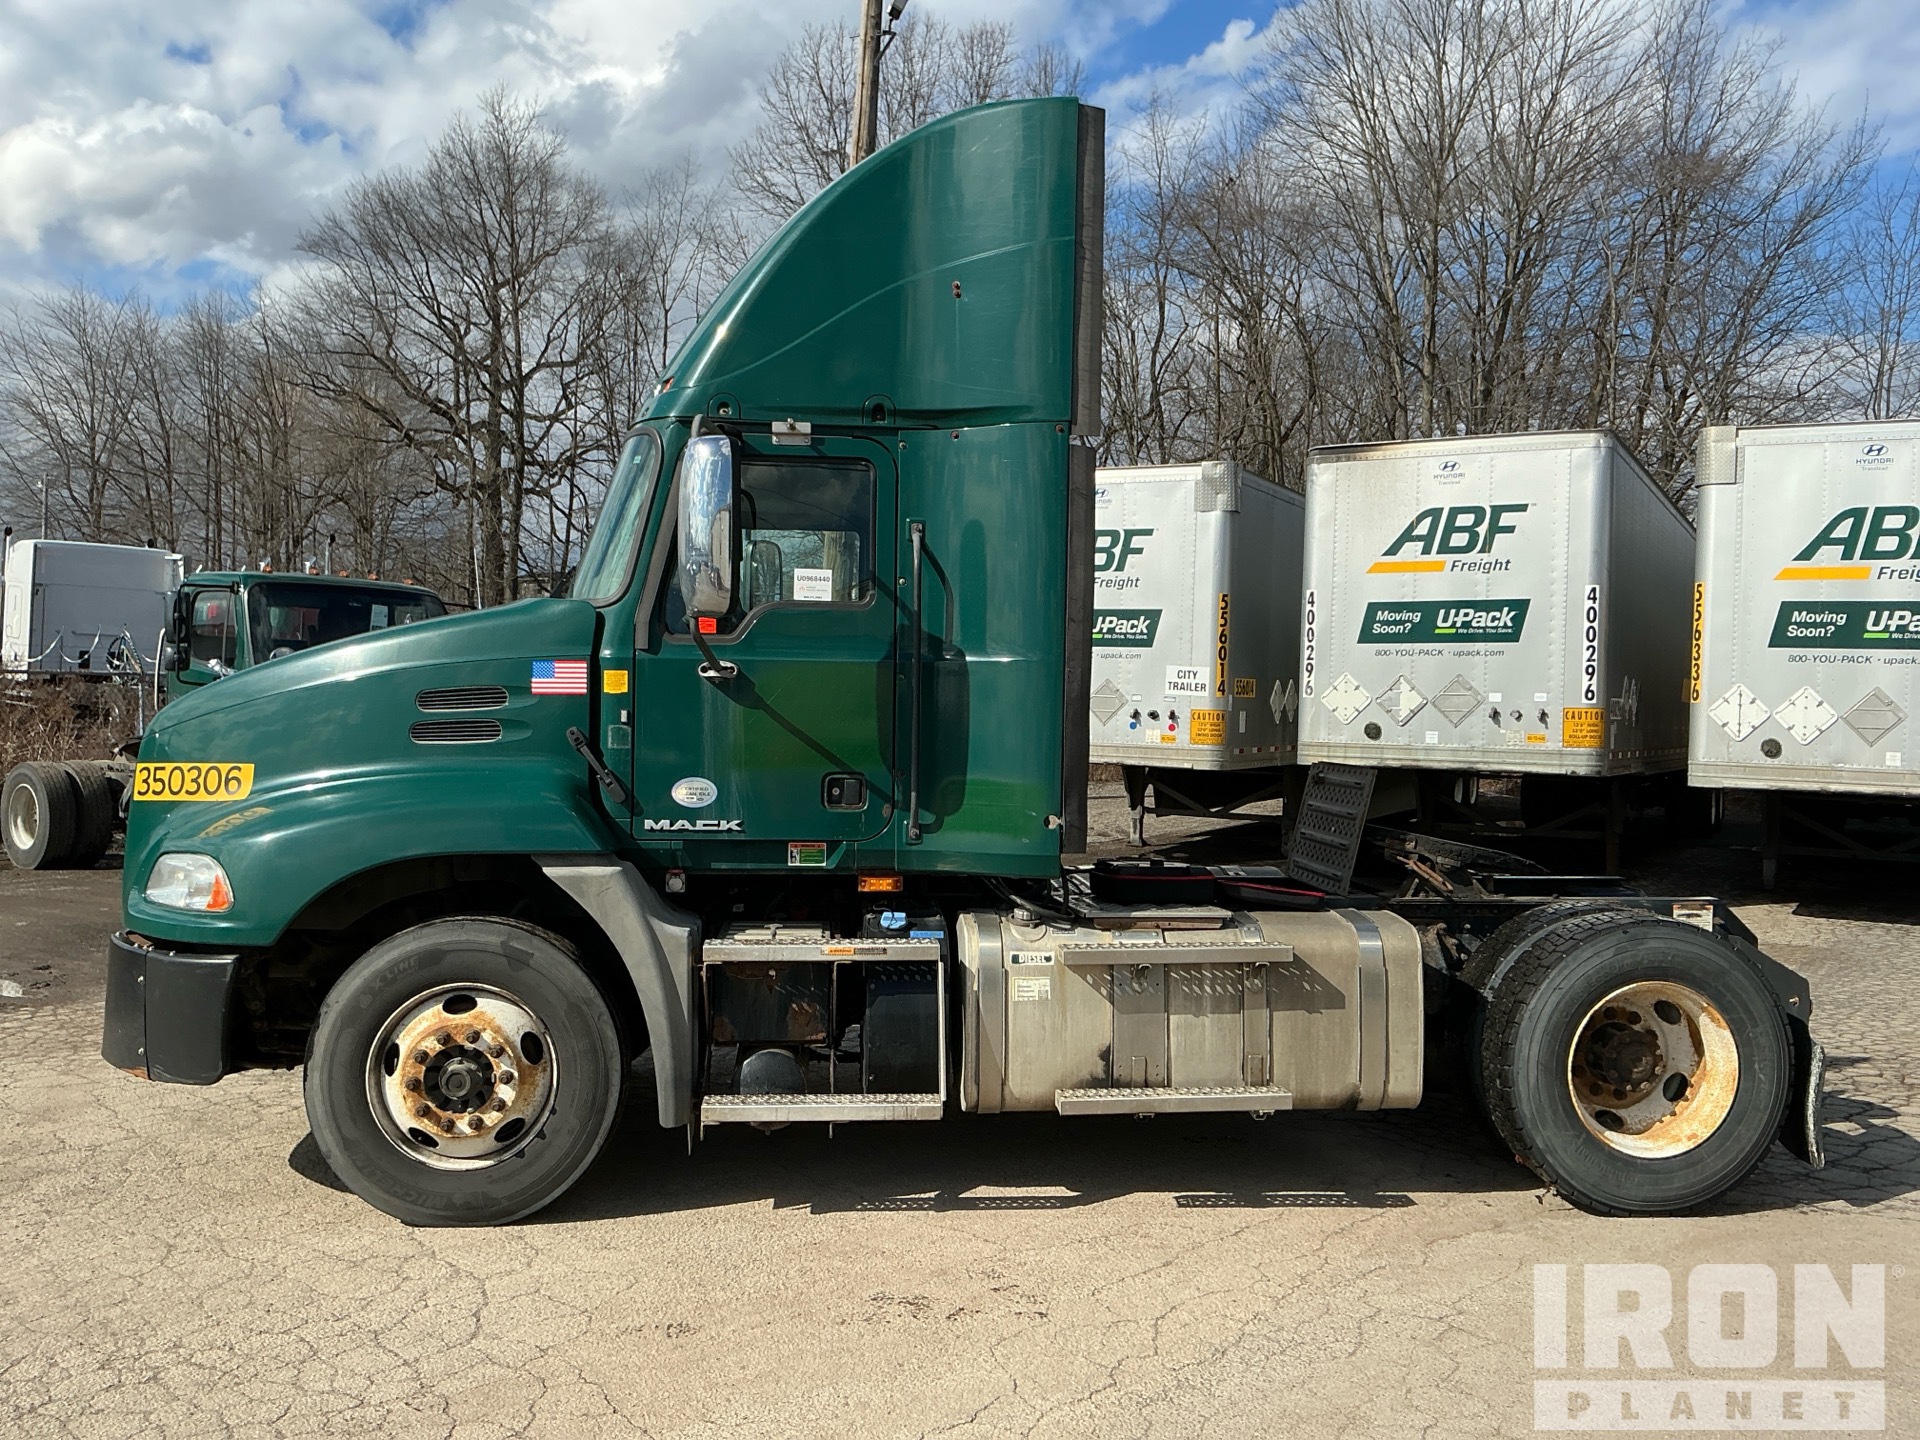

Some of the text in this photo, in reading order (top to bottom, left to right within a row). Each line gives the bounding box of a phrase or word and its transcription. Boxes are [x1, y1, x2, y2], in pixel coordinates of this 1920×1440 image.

[1433, 472, 1466, 480] HYUNDAI
[1381, 503, 1529, 557] ABF
[1791, 505, 1920, 561] AB
[1094, 528, 1155, 572] BF
[1450, 558, 1511, 574] Freight
[1877, 564, 1920, 583] Freig
[1375, 610, 1421, 622] Moving
[1791, 611, 1847, 625] Moving
[1866, 610, 1920, 632] U-Pa
[1372, 623, 1412, 634] Soon?
[1787, 625, 1835, 637] Soon?
[1217, 594, 1229, 695] 556014
[1304, 591, 1316, 696] 400296
[1585, 587, 1598, 701] 400296
[1691, 584, 1703, 701] 556336
[1100, 652, 1141, 660] upack.com
[1374, 649, 1505, 658] 800-YOU-PACK upack.com
[1788, 654, 1873, 664] 800-YOU-PACK
[1177, 670, 1198, 680] CITY
[1168, 681, 1207, 693] TRAILER
[1192, 712, 1226, 721] CAUTION
[1565, 711, 1604, 721] CAUTION
[137, 765, 243, 796] 350306
[644, 819, 742, 830] MACK
[1019, 953, 1048, 963] DIESEL
